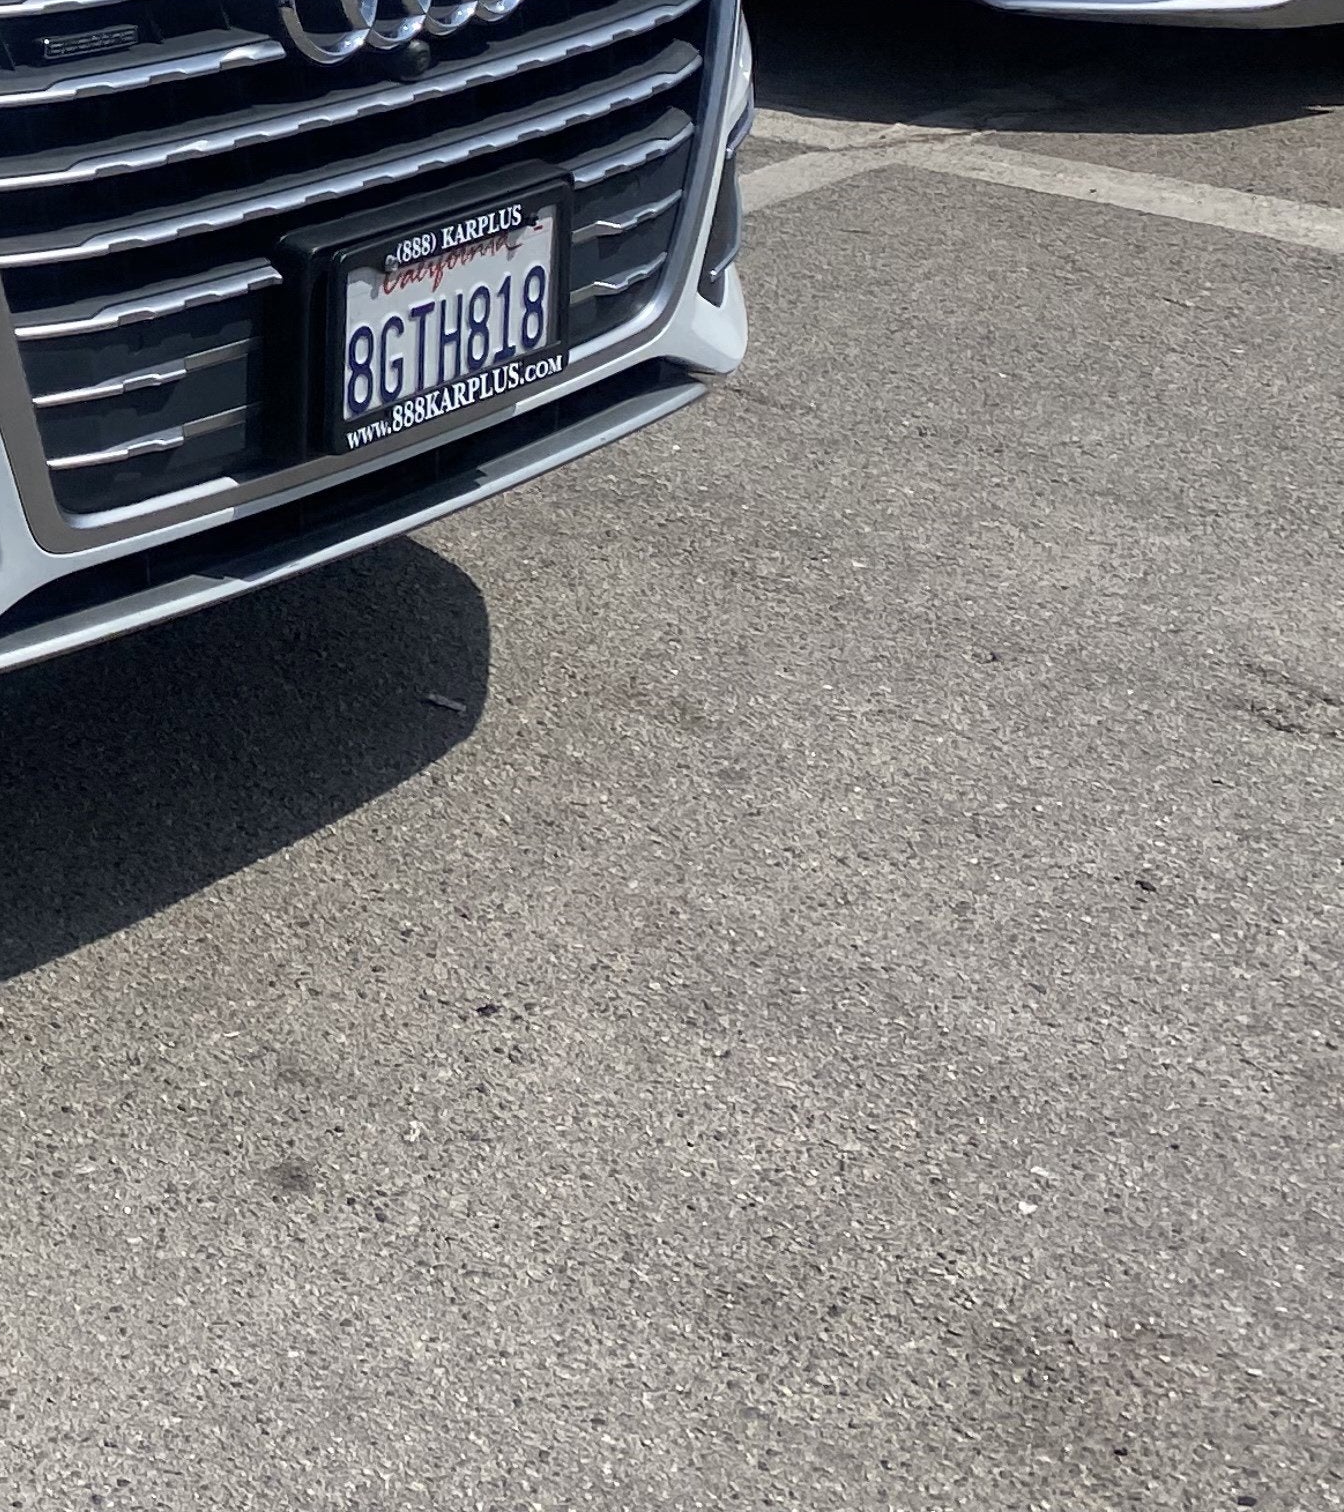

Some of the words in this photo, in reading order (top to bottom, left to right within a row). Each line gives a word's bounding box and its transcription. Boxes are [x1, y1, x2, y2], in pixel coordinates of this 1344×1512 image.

[396, 231, 437, 263] (888)
[441, 204, 523, 249] KARPLUS
[347, 264, 546, 414] 8GTH818
